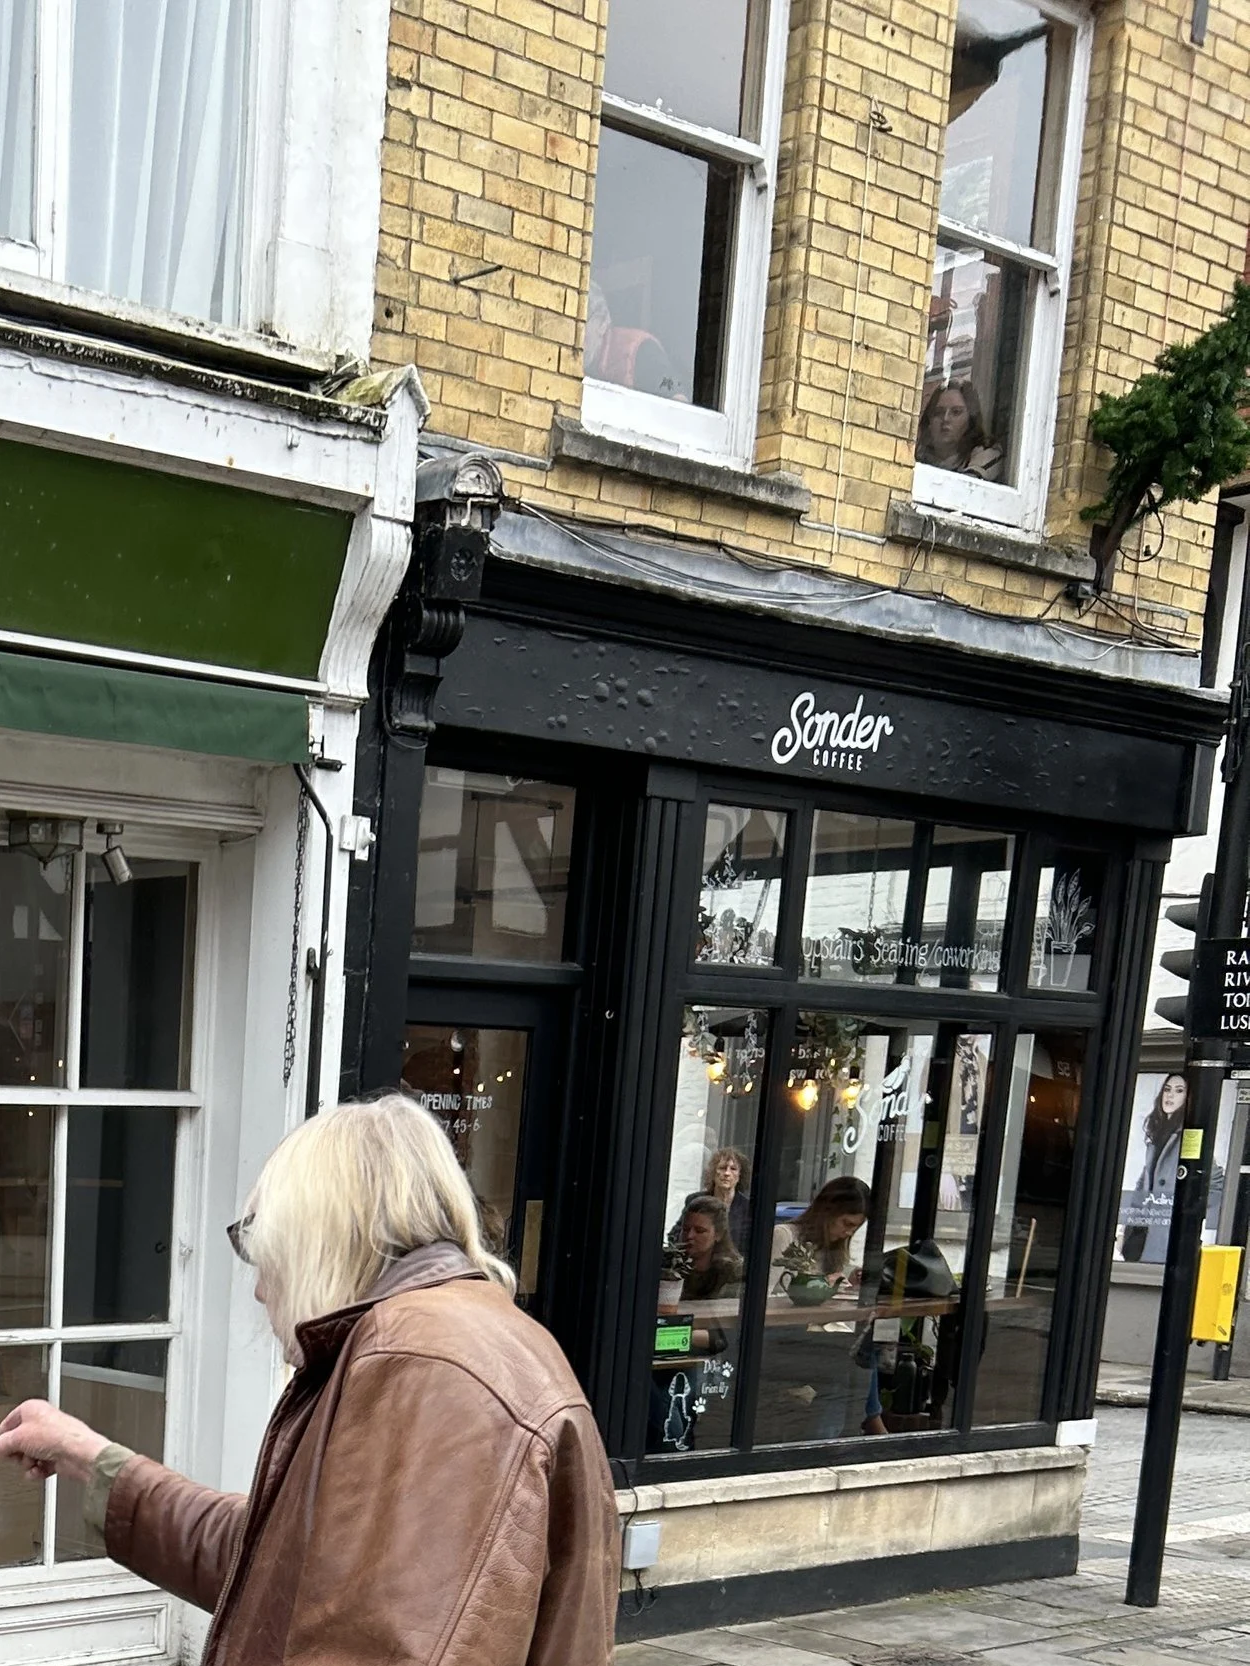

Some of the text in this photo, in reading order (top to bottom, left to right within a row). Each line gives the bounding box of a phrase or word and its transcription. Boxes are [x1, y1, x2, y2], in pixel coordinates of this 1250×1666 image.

[771, 691, 894, 765] Sonder
[813, 748, 863, 771] COFFEE
[1220, 1015, 1250, 1030] LUS
[843, 1085, 933, 1154] Sond
